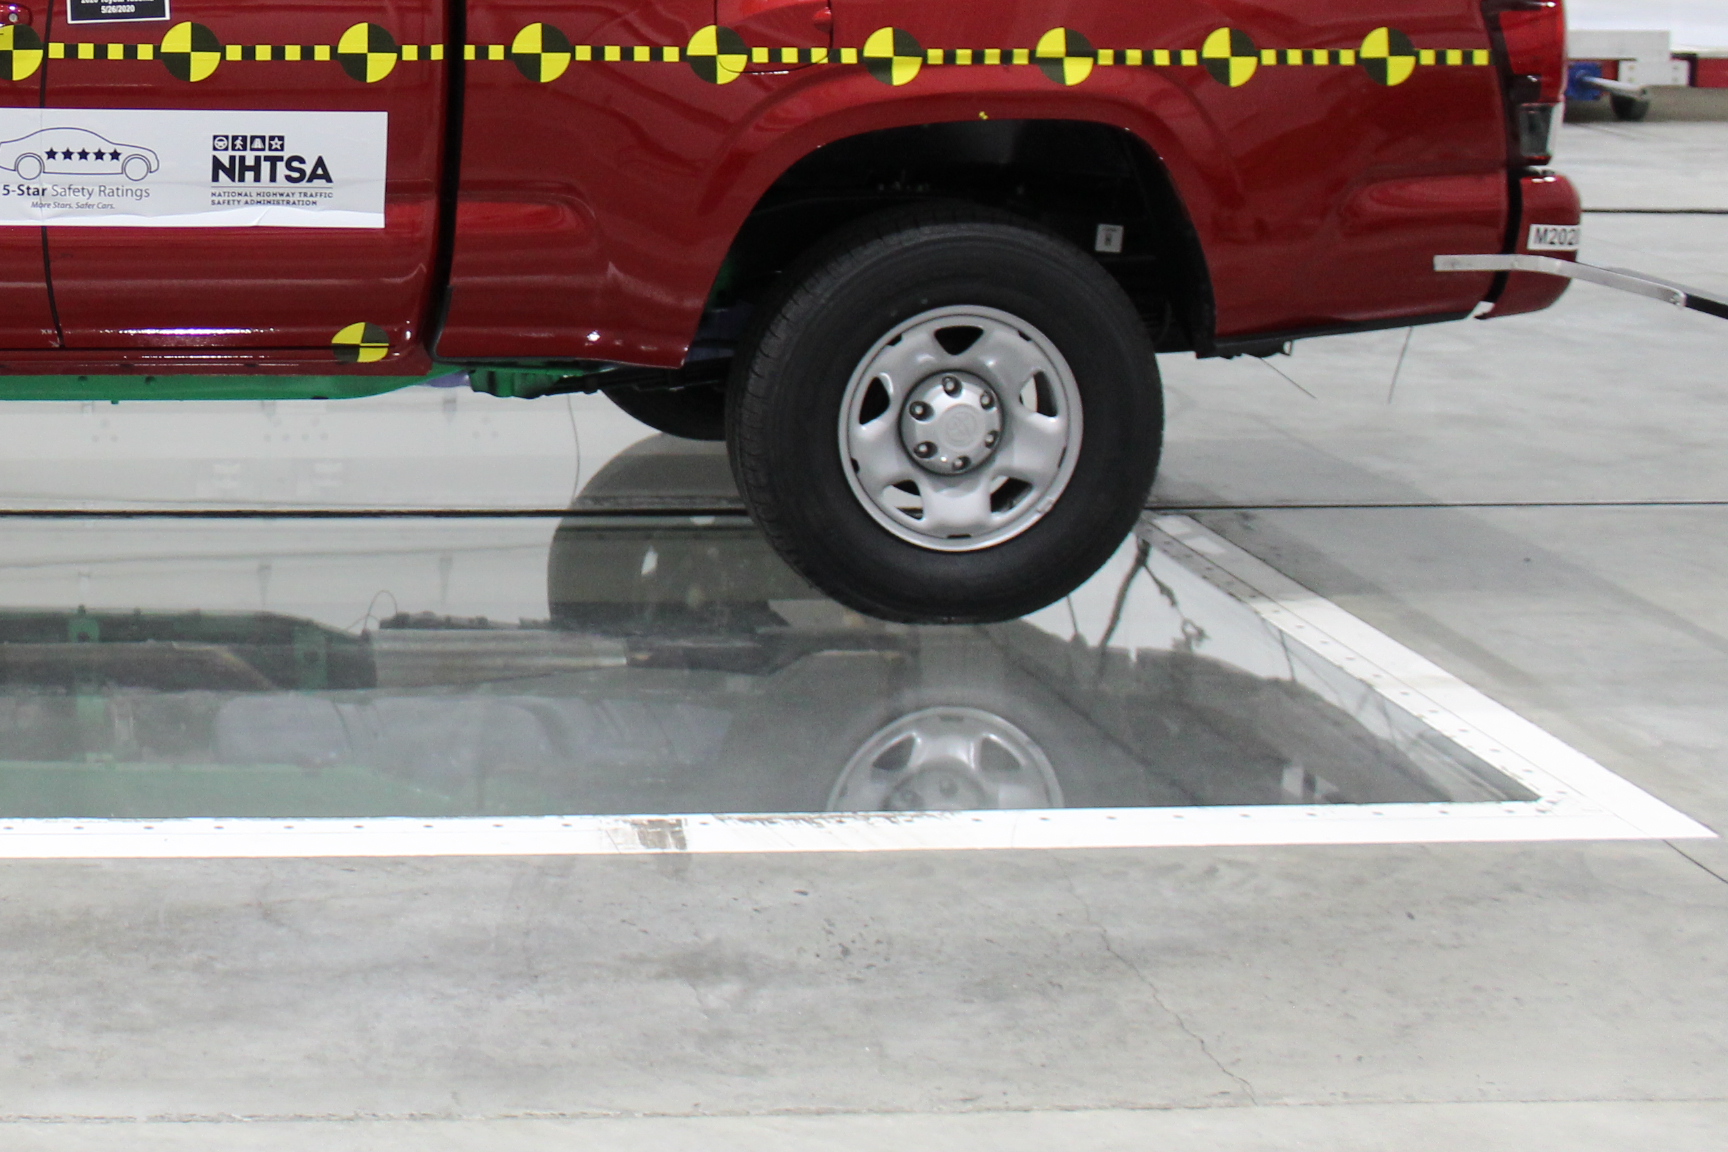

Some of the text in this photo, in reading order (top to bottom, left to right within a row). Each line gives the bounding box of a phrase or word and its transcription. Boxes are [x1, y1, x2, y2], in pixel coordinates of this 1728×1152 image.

[100, 4, 136, 14] 5/26/2020
[211, 154, 334, 184] NHTSA
[1, 184, 151, 201] 5-Star Safety Ratings
[298, 191, 334, 199] TRAFFIC
[30, 201, 116, 210] More Stars. Safer Cars.
[1534, 227, 1580, 246] M202
